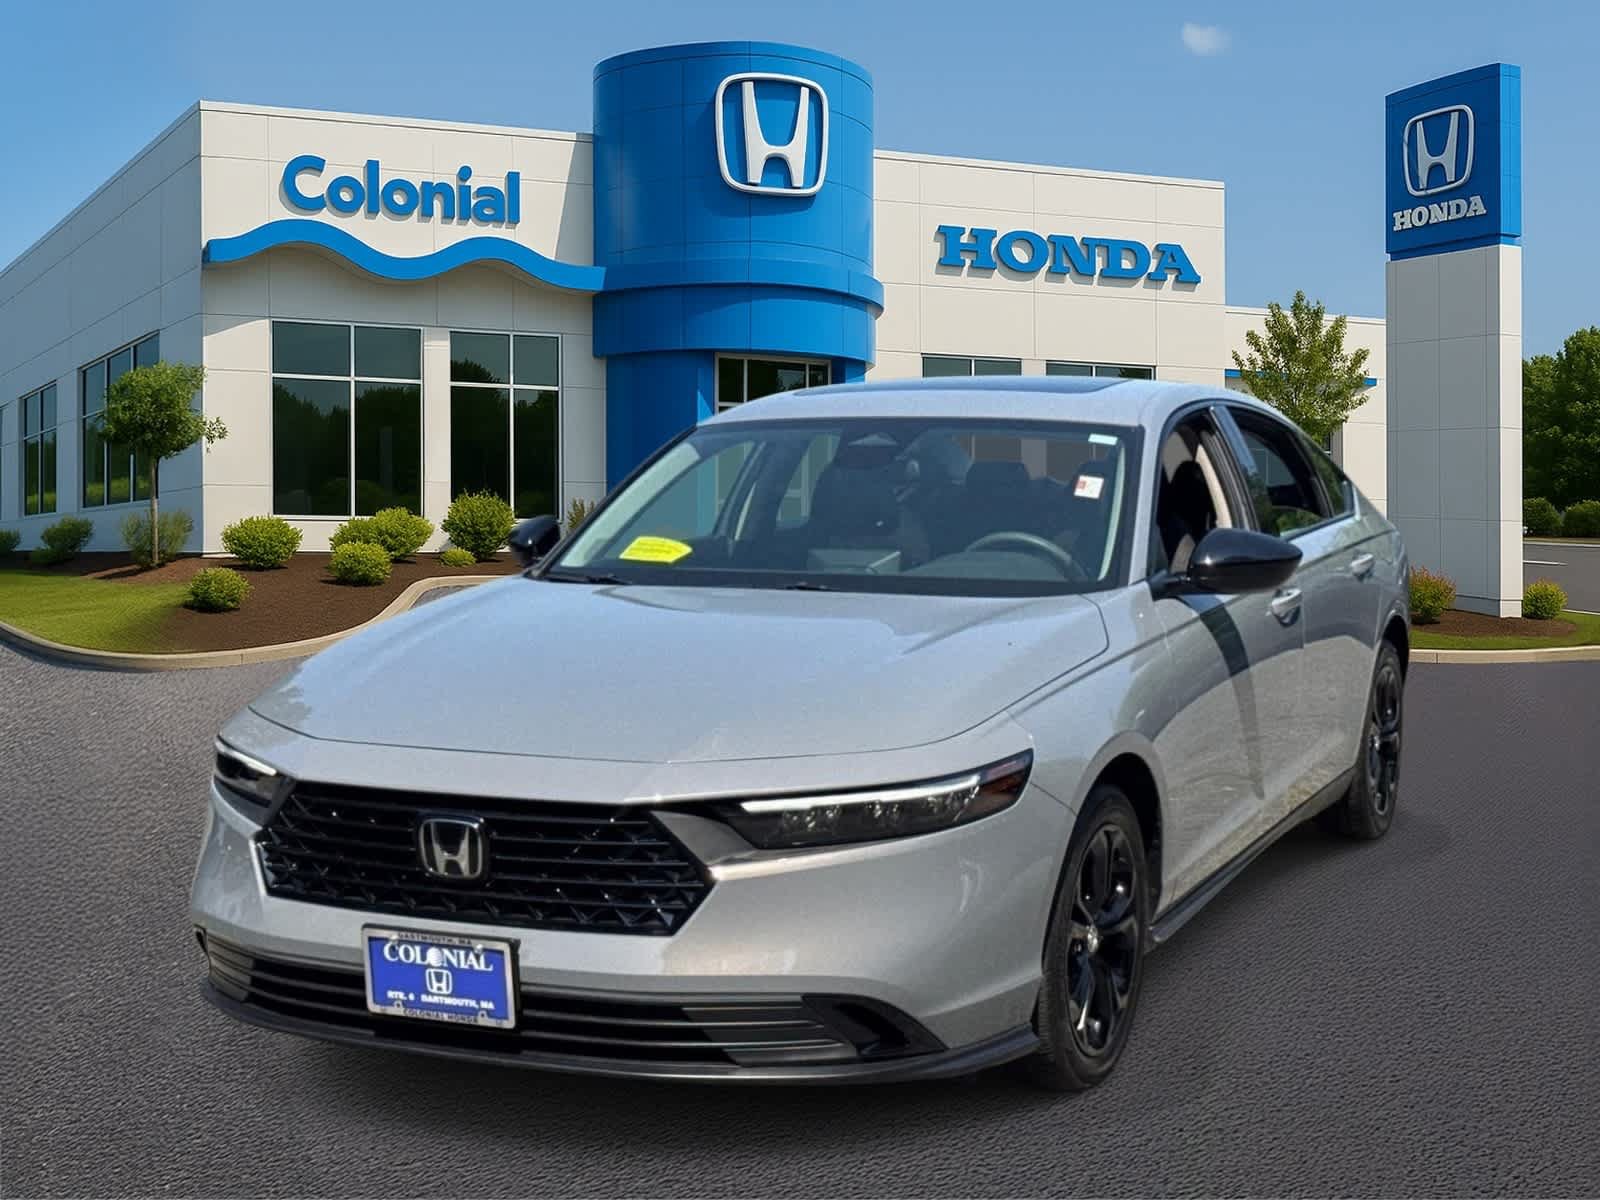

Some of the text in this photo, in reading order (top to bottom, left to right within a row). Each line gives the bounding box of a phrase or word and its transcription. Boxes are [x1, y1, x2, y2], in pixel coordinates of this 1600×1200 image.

[281, 154, 521, 226] Colonial
[1392, 195, 1487, 232] HONDA
[936, 224, 1202, 285] HONDA
[383, 942, 494, 972] COLONIAL
[480, 1001, 495, 1010] MA
